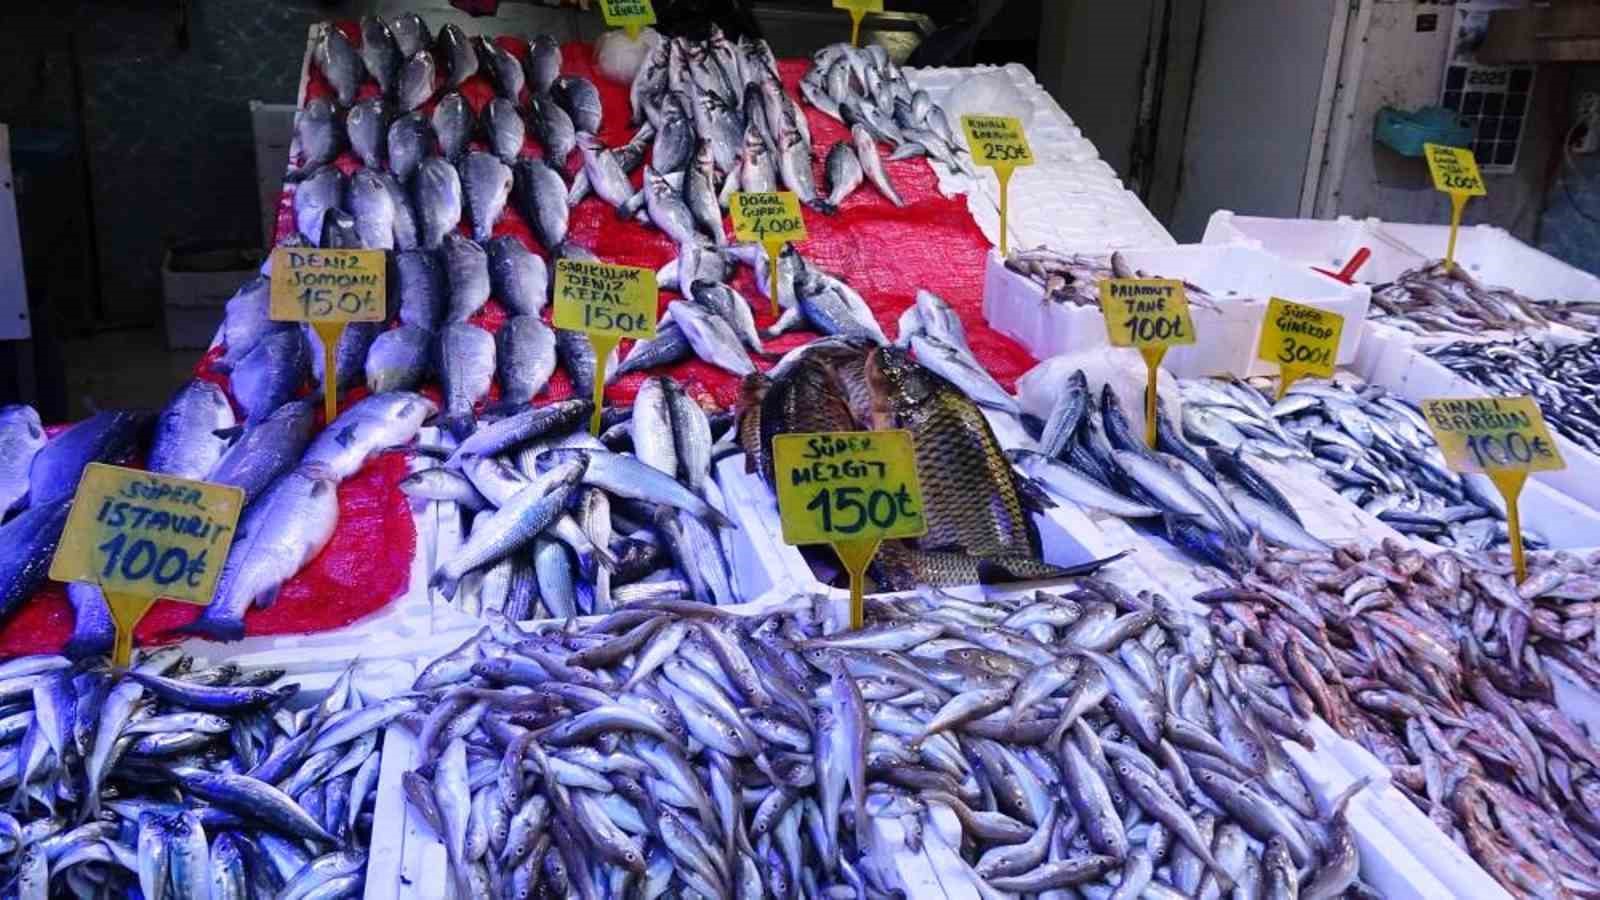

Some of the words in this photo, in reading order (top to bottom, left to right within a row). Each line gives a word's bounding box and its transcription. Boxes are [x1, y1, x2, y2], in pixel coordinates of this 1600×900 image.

[558, 262, 640, 282] SARIKULAK
[1110, 283, 1174, 297] PALAMUT
[1125, 298, 1166, 314] TANE
